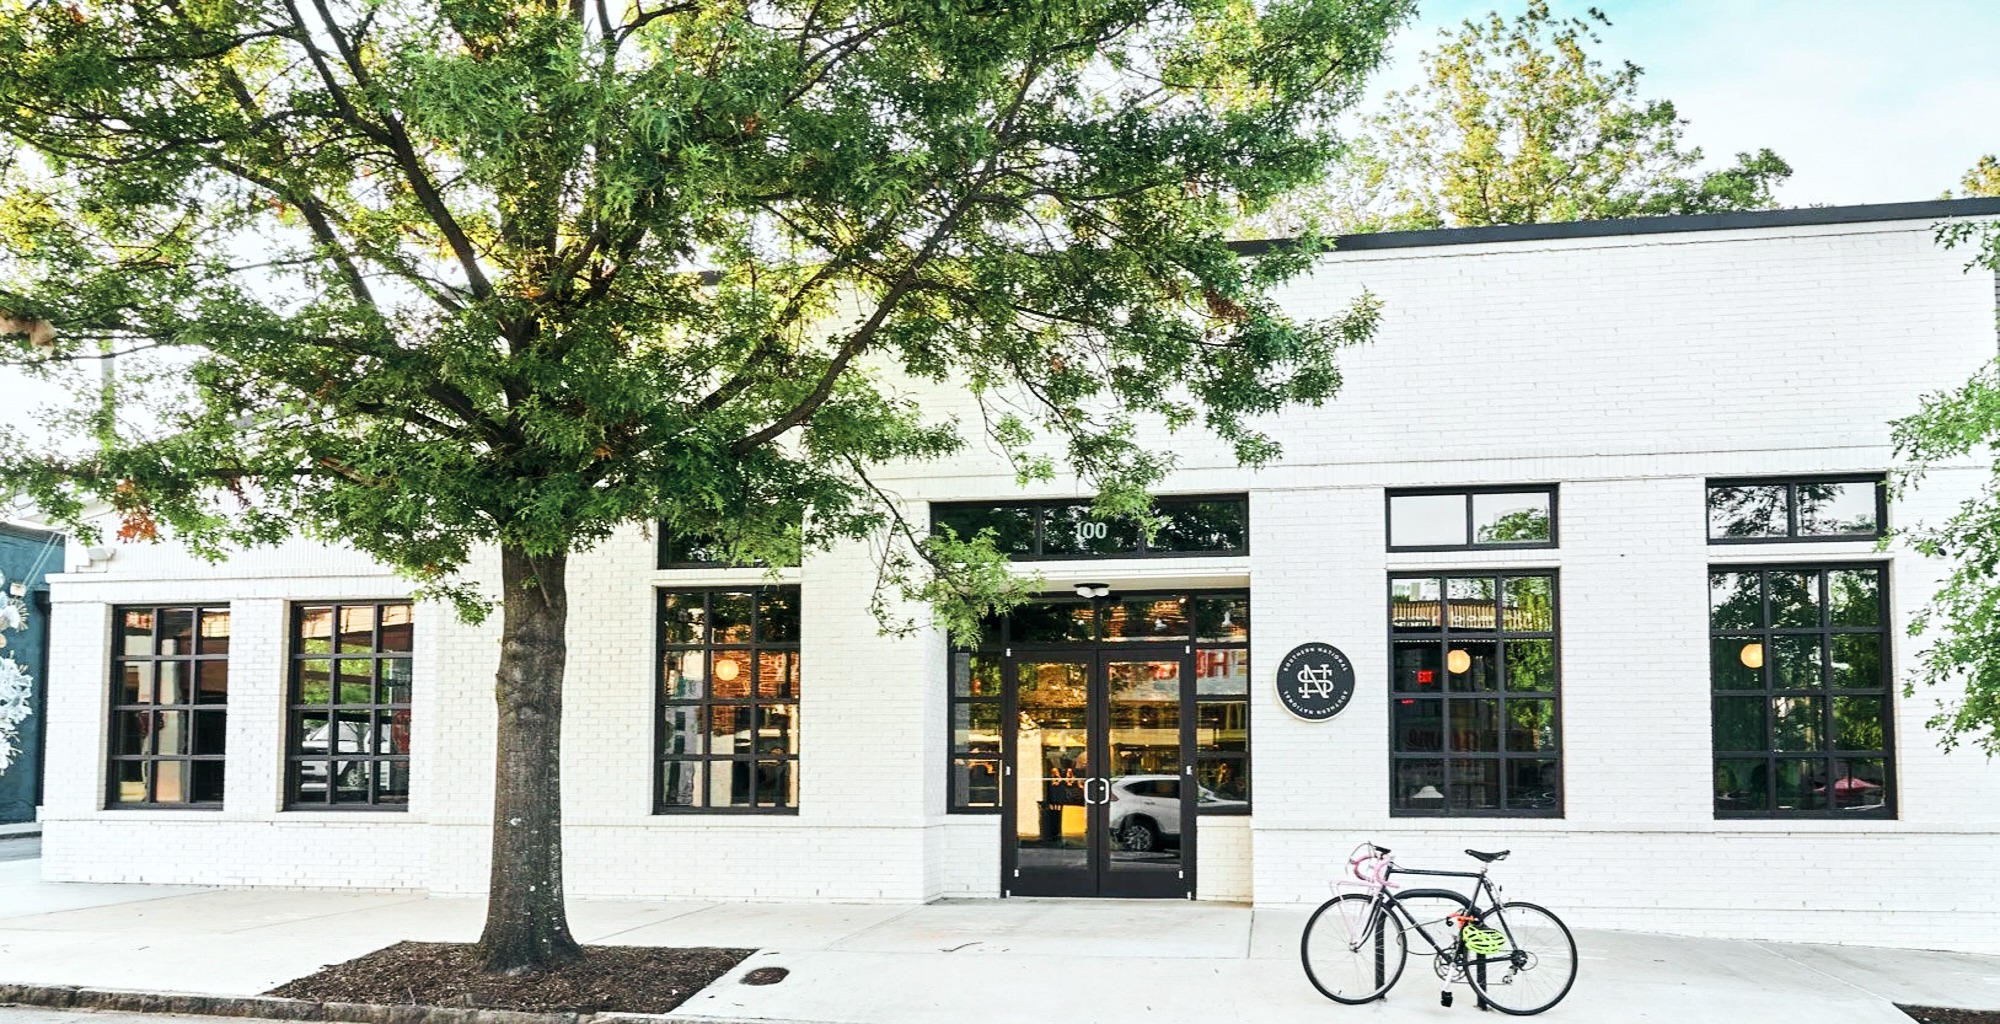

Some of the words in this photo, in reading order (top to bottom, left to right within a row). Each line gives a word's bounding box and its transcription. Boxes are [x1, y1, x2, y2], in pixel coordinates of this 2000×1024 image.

[1076, 522, 1107, 539] 100
[1283, 647, 1315, 672] SOUTHERN
[1317, 647, 1348, 671] NATIONAL
